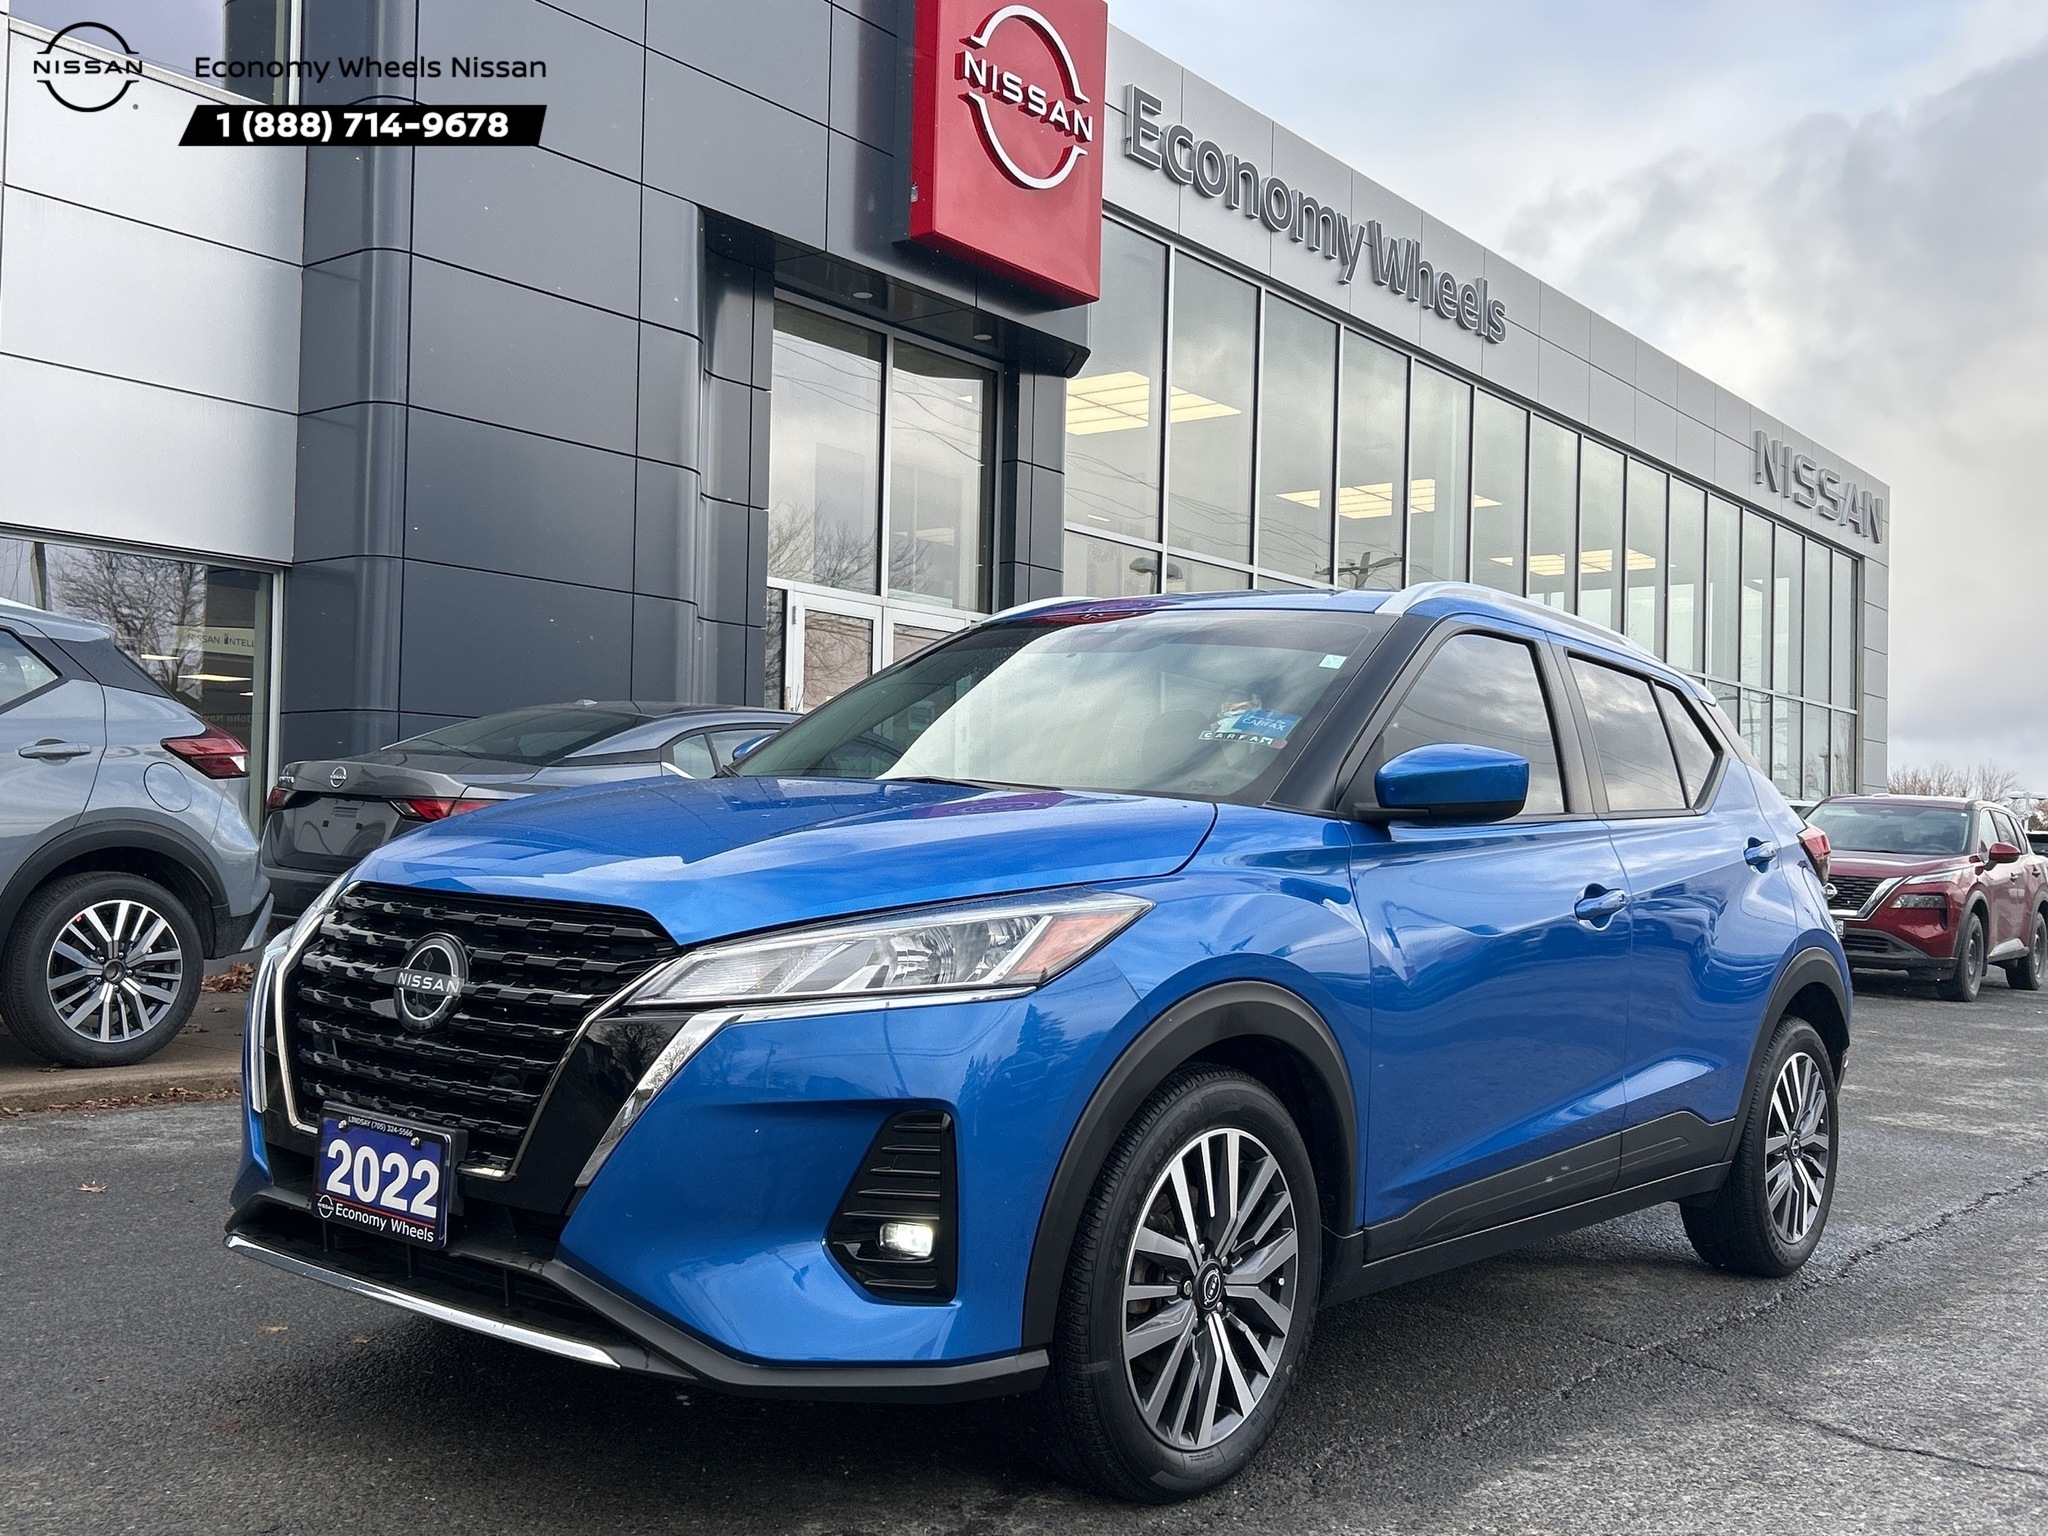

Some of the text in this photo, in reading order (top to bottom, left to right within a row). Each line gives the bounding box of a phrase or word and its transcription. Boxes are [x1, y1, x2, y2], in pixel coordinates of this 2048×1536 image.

[958, 50, 1093, 142] NISSAN
[1124, 83, 1507, 344] Economy Wheels
[1753, 429, 1885, 544] NISSAN
[397, 971, 460, 993] NISSAN
[326, 1138, 440, 1218] 2022
[335, 1203, 388, 1232] Economy
[390, 1218, 434, 1243] Wheels
